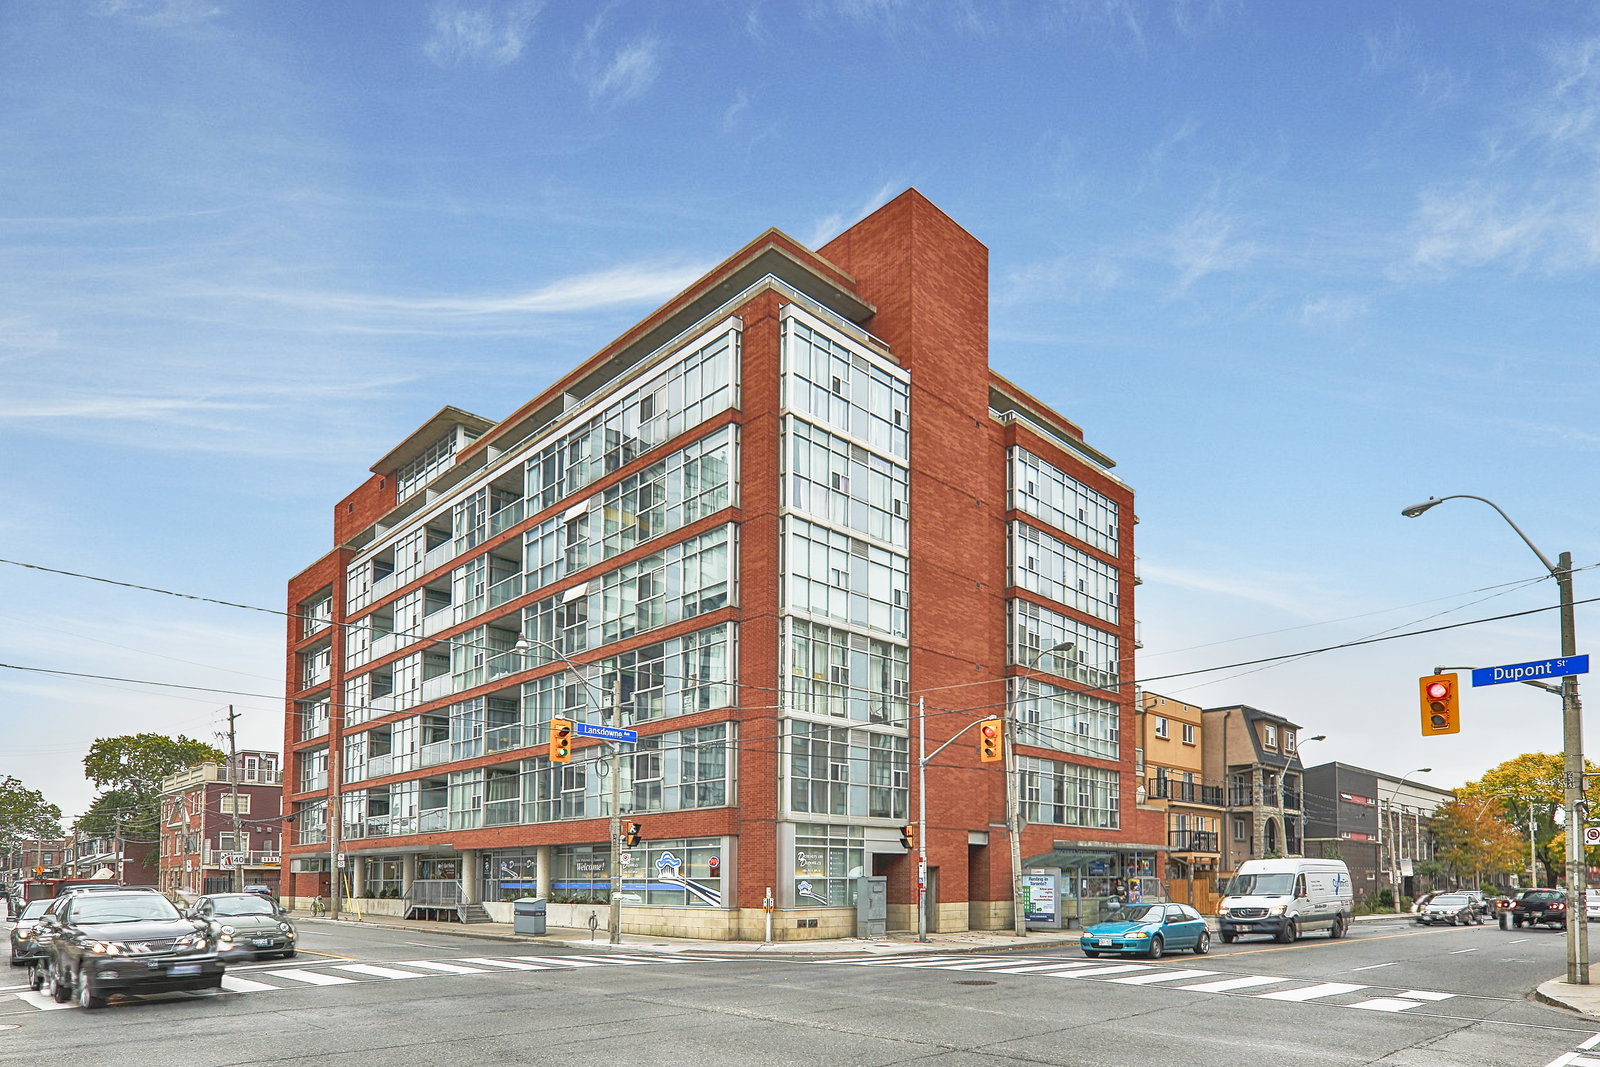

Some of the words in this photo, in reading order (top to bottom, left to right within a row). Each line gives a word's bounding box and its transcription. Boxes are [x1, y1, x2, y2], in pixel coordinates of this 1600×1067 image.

[1493, 661, 1552, 681] Dupont
[584, 725, 623, 738] Lansdowne
[576, 862, 605, 871] Welcome!
